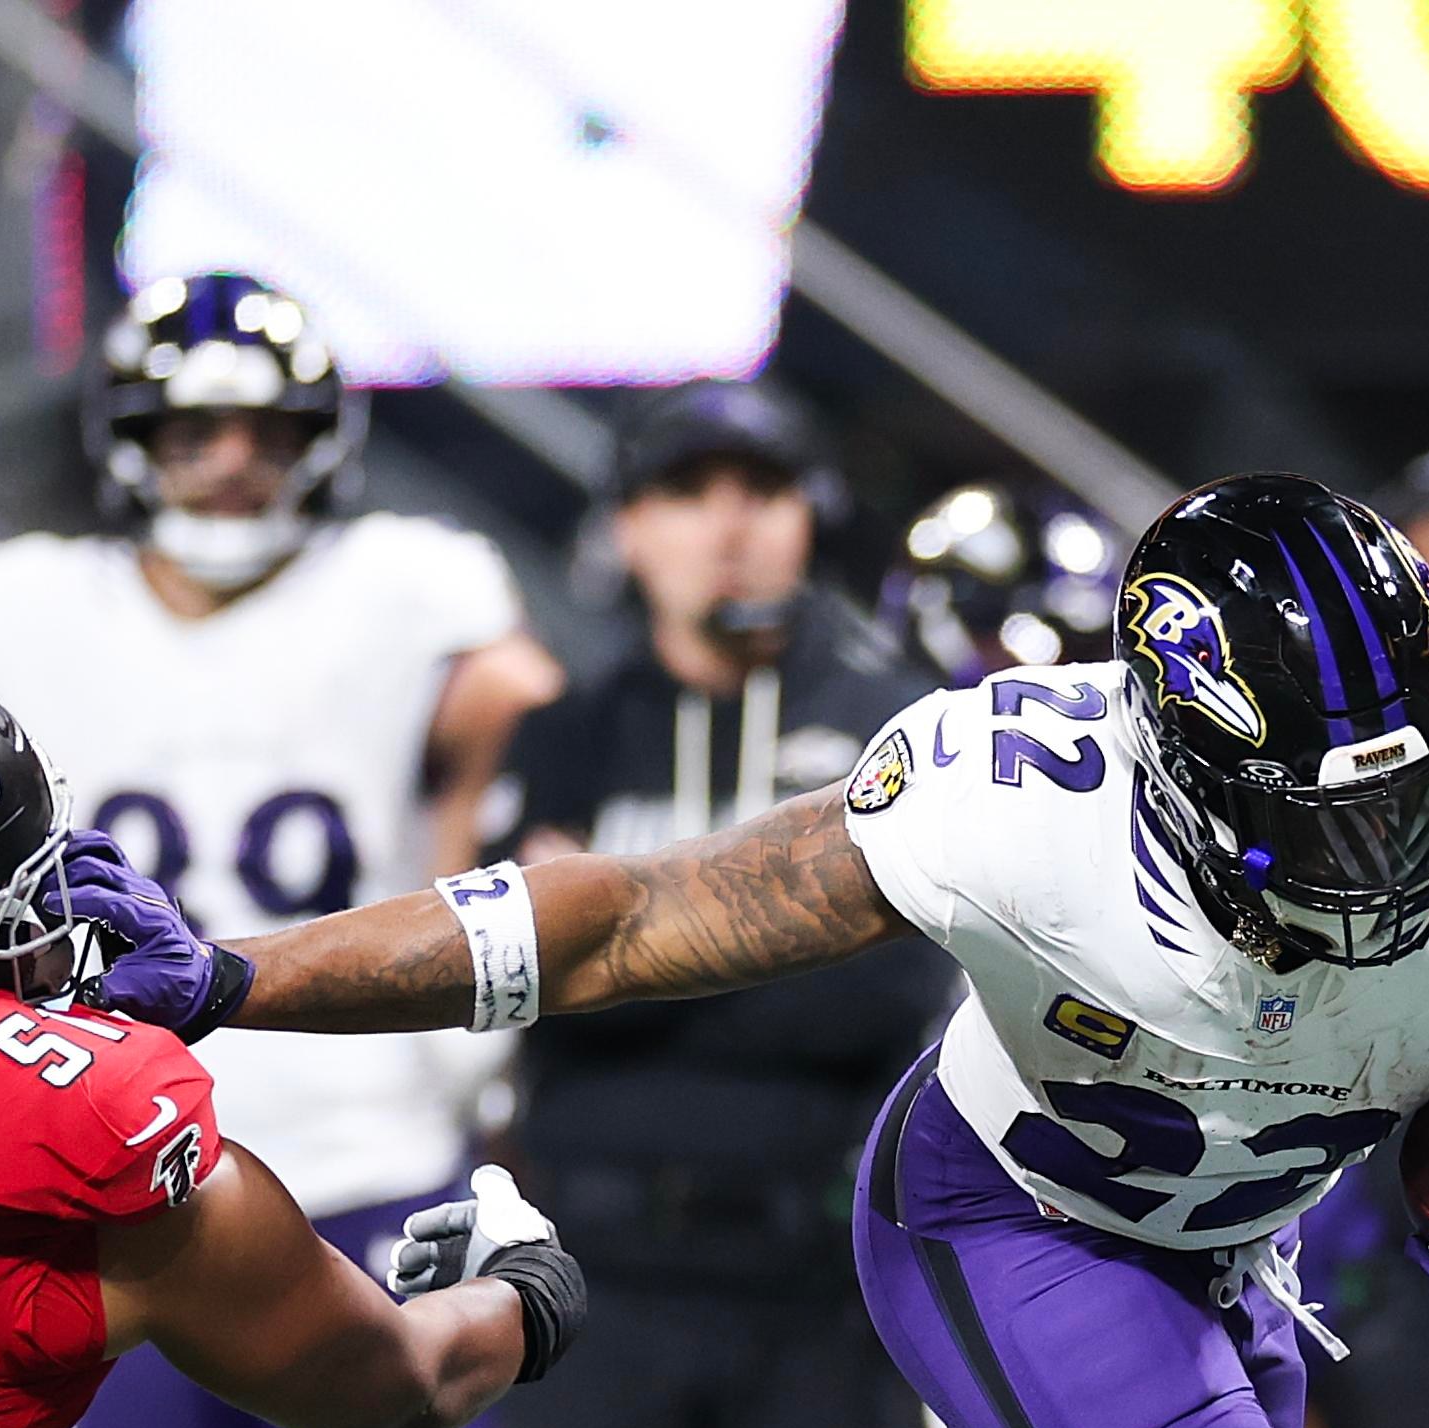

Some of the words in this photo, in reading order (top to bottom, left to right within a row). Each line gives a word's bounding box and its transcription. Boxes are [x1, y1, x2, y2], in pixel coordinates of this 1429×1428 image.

[991, 679, 1108, 794] 22
[1352, 743, 1406, 769] RAVENS
[1260, 1013, 1291, 1030] NFL
[1143, 1067, 1352, 1101] BALTIMORE
[1000, 1080, 1402, 1232] 22
